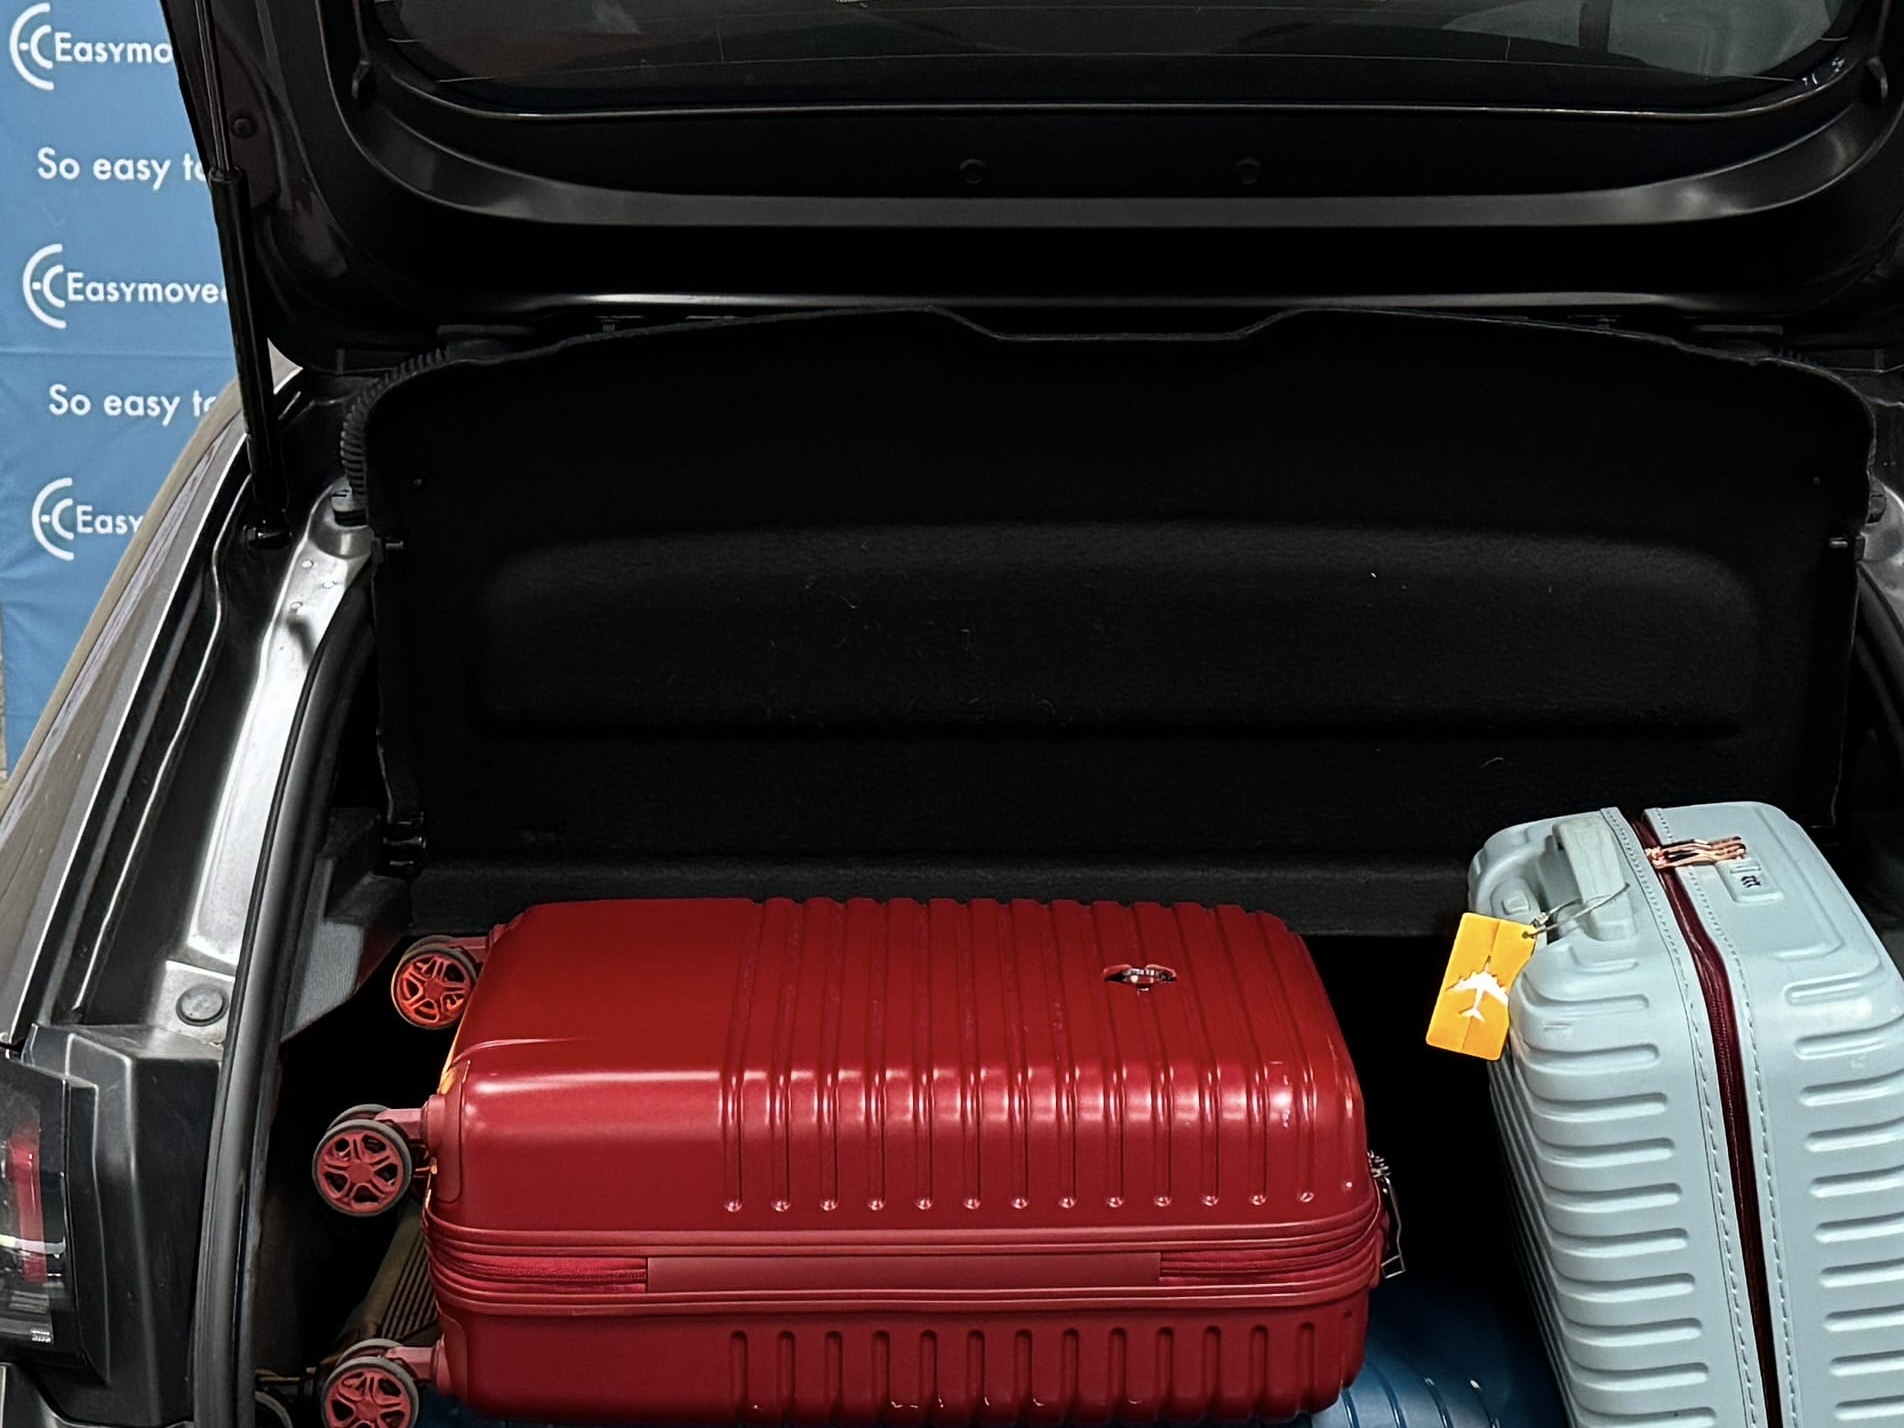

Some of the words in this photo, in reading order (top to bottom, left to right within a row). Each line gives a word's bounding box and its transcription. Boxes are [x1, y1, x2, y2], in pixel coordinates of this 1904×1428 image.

[37, 146, 81, 180] So
[92, 158, 171, 191] easy
[66, 271, 228, 304] Easymove
[49, 383, 92, 416] So
[103, 394, 181, 427] easy
